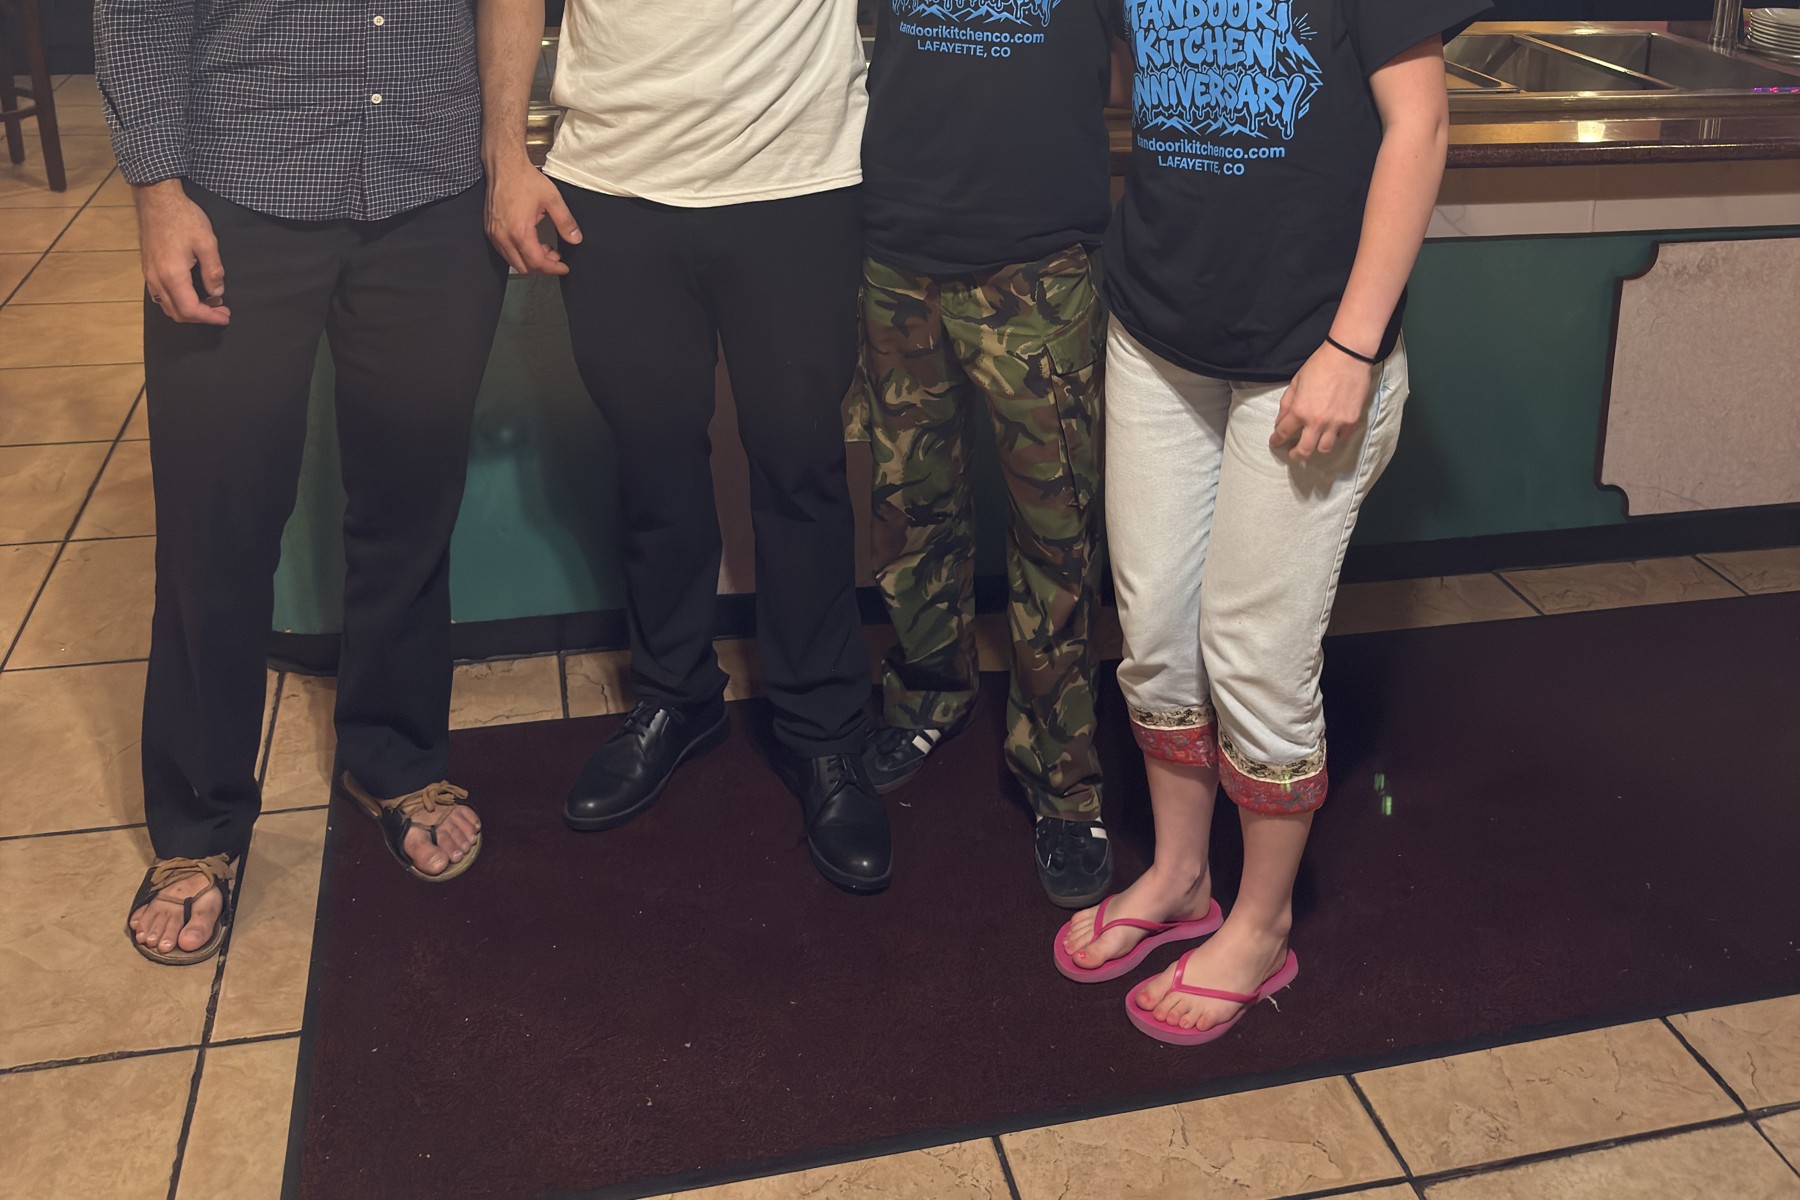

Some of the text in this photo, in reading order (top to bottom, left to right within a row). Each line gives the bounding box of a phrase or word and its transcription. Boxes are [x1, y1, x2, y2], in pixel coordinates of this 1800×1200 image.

[899, 21, 1045, 44] tandoorikitchenco.com
[917, 39, 1011, 58] LAFAYETTE, CO
[1137, 134, 1285, 158] tandoorikitchenco.com
[1158, 155, 1245, 175] LAFAYETTE, CO
